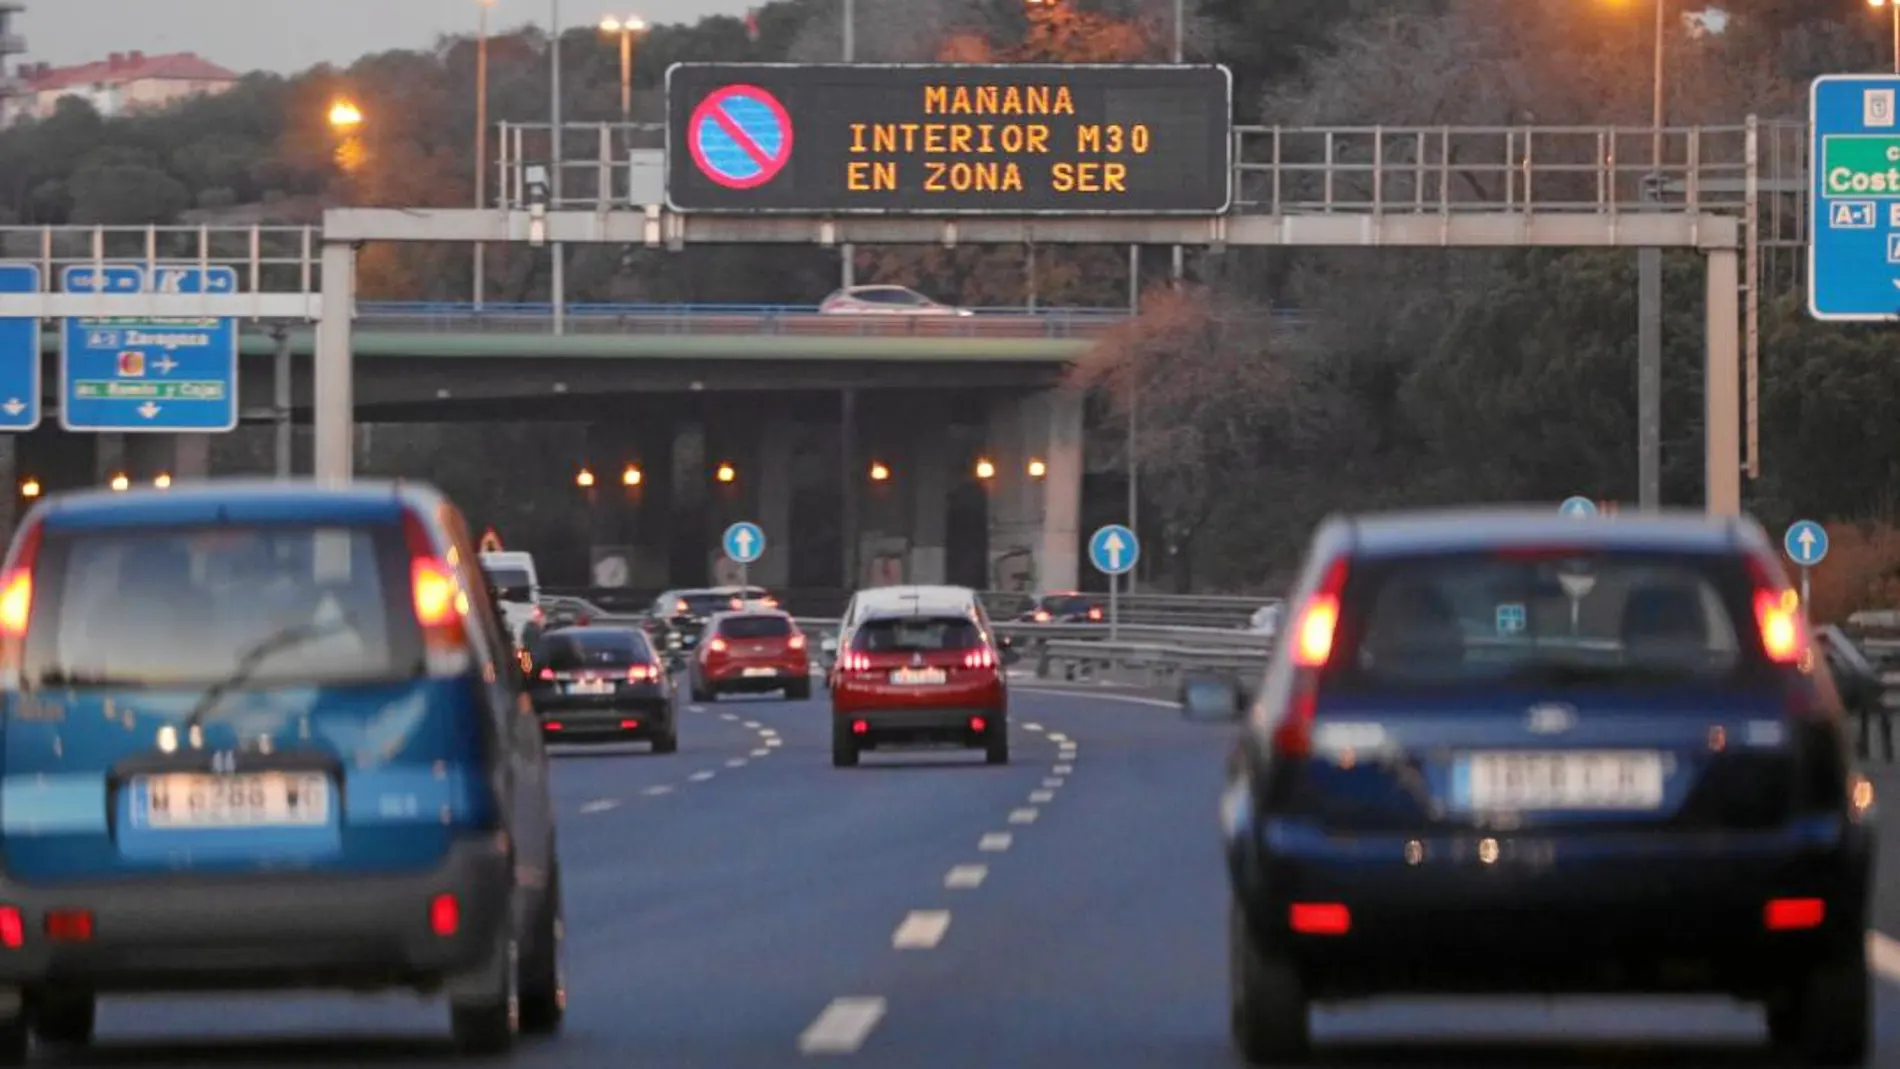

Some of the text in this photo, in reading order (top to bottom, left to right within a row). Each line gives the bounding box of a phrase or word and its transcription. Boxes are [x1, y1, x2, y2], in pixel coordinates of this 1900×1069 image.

[924, 85, 1075, 116] MAÑANA
[849, 122, 1150, 154] INTERIOR M30
[847, 161, 1127, 193] EN ZONA SER
[1835, 205, 1871, 225] A-1
[125, 330, 209, 350] Zaragoza
